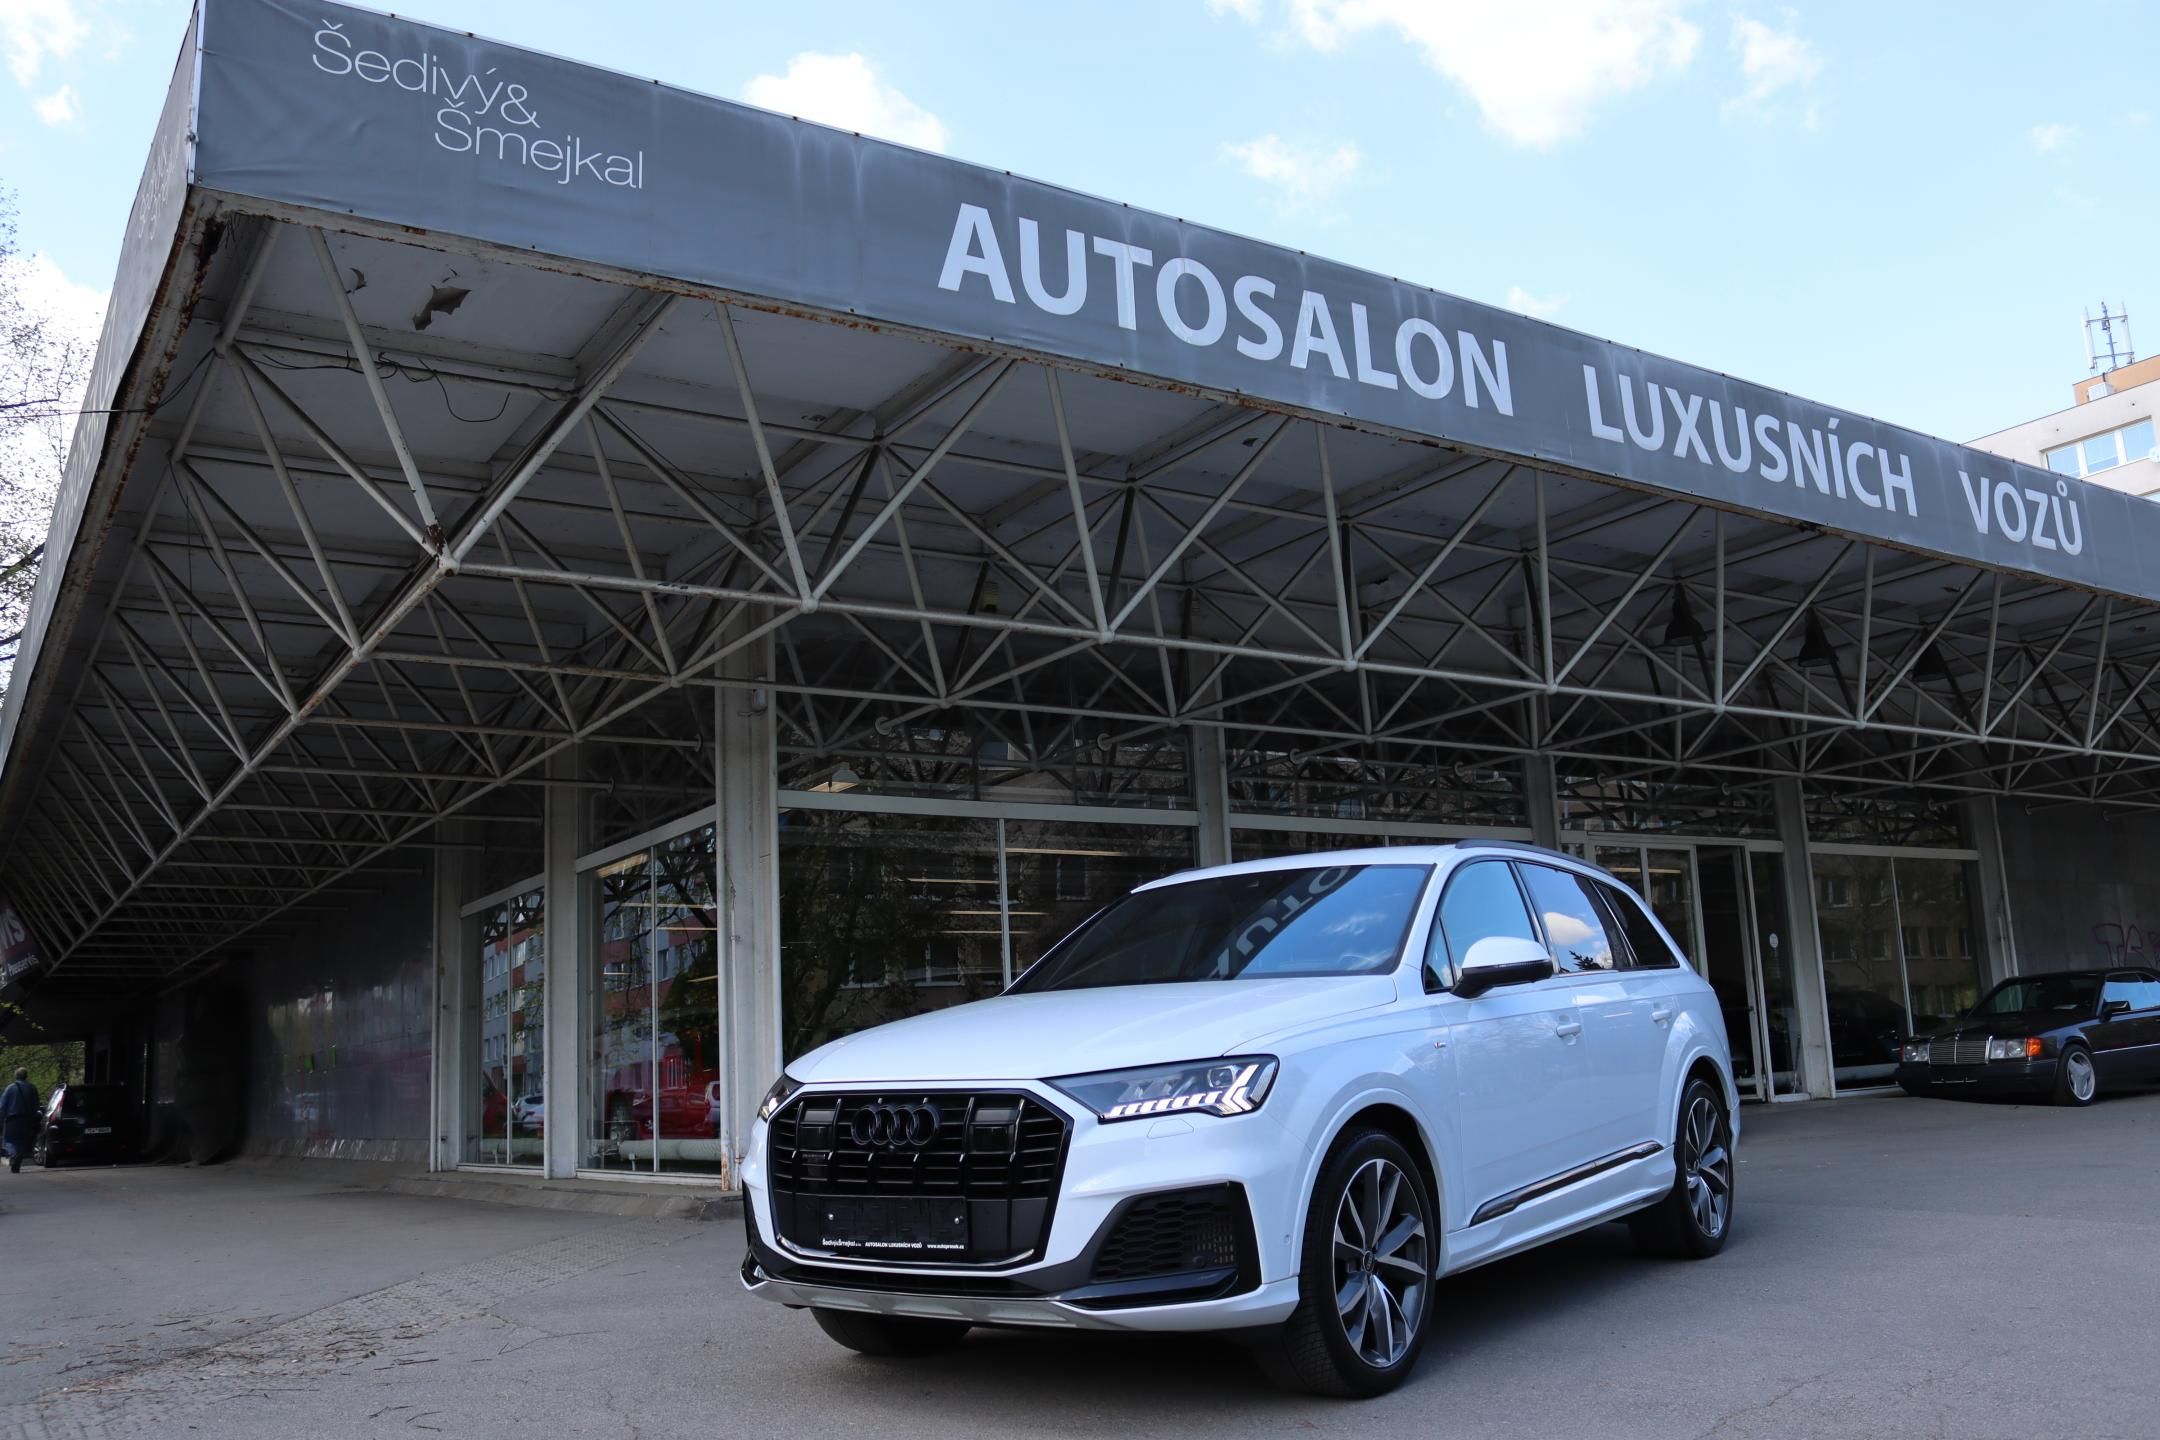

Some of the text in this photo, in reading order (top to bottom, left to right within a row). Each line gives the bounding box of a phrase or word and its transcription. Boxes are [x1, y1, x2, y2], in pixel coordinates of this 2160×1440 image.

[313, 19, 541, 128] Šedivý&
[435, 98, 643, 189] Šmejkal
[938, 203, 2083, 556] AUTOSALON LUXUSNÍCH VOZŮ
